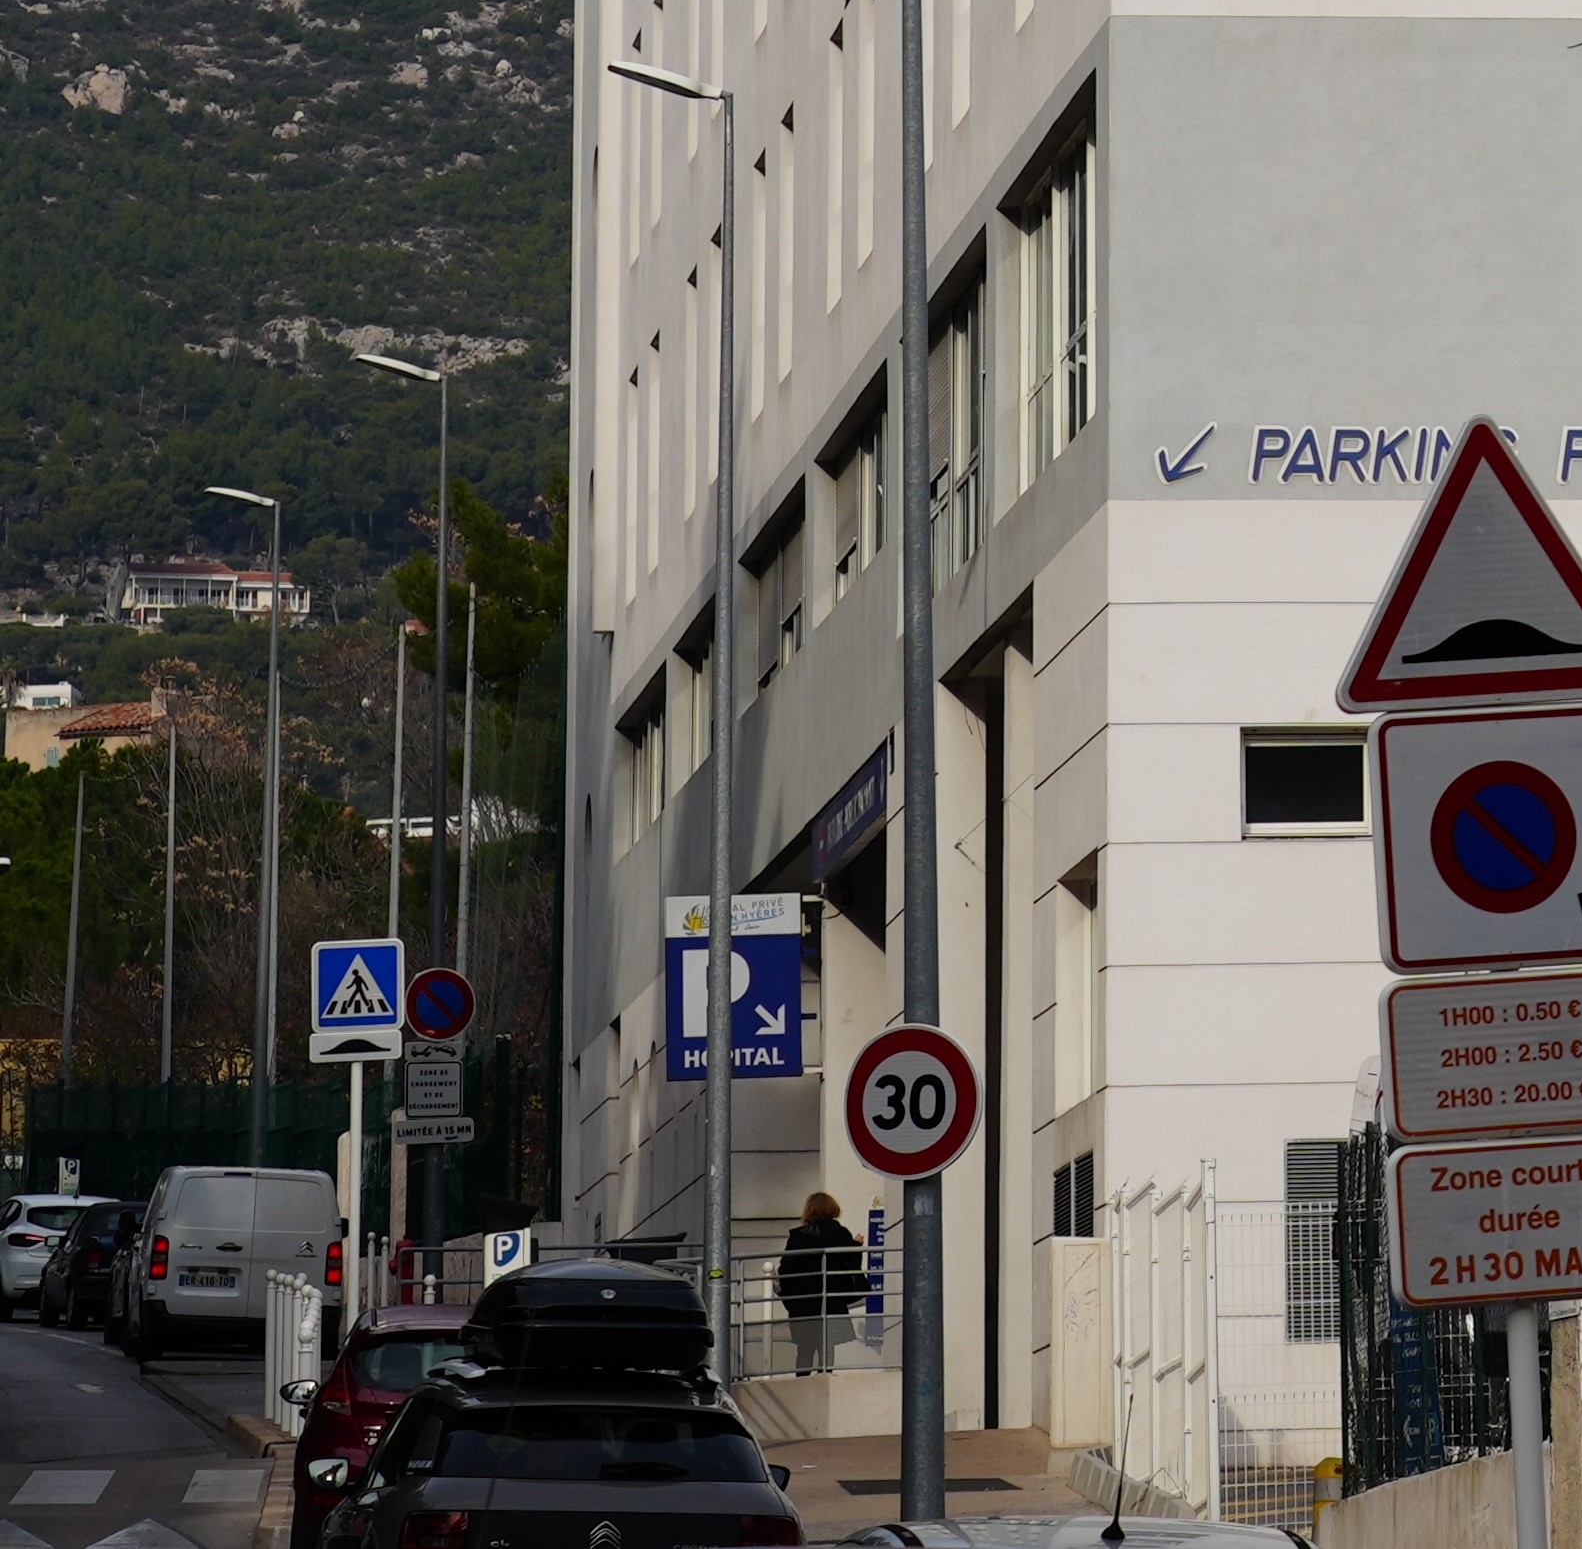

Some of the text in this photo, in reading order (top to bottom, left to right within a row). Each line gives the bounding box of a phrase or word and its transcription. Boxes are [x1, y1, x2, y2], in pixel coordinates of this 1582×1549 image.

[1250, 427, 1519, 483] PARKIN
[1438, 1005, 1495, 1027] 1H00
[1516, 1000, 1561, 1022] 0.50
[1567, 999, 1581, 1018] €
[684, 1047, 785, 1069] HITAL
[1441, 1045, 1498, 1067] 2H00
[1518, 1040, 1563, 1062] 2.50
[871, 1073, 948, 1131] 30
[1436, 1087, 1493, 1109] 2H30
[1514, 1081, 1573, 1103] 20.00
[397, 1126, 433, 1138] LIMITÉE
[444, 1125, 455, 1136] 15
[456, 1124, 472, 1135] MN
[1430, 1166, 1503, 1192] Zone
[1478, 1204, 1561, 1234] durée
[496, 1235, 514, 1262] P
